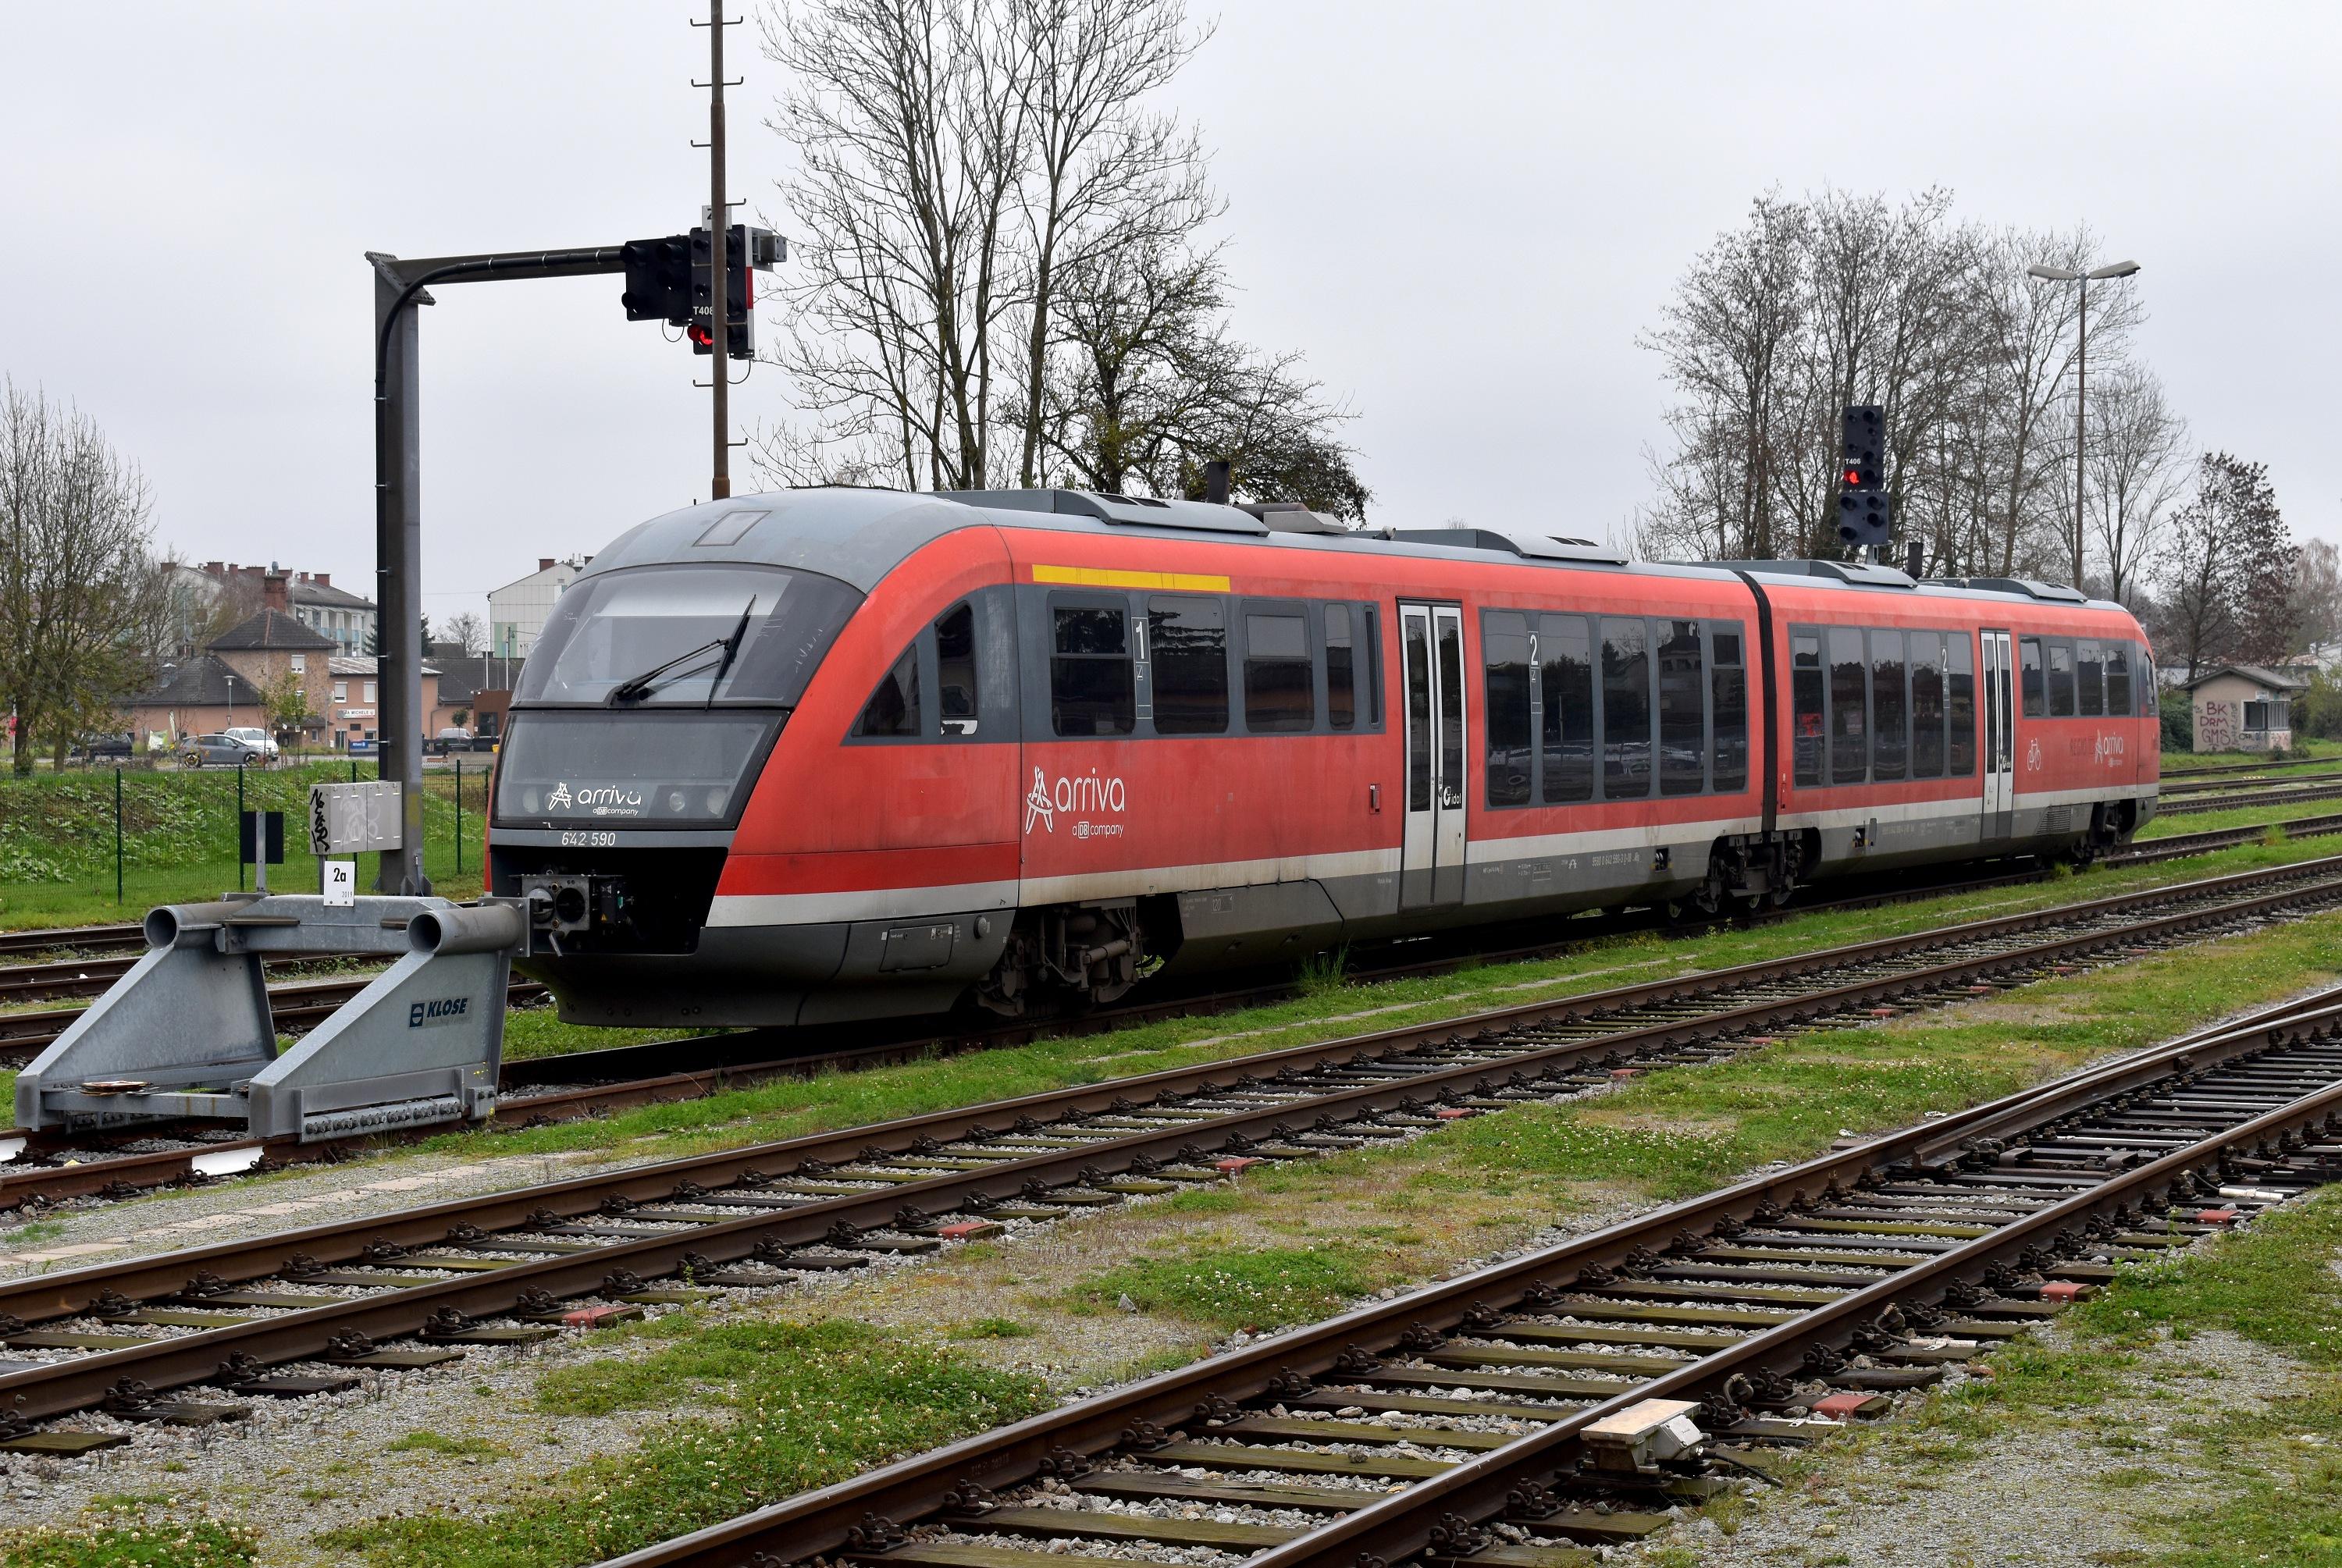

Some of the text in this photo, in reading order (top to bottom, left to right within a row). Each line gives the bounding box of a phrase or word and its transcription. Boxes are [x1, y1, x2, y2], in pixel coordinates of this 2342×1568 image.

[1135, 621, 1144, 659] 1
[1530, 635, 1539, 665] 2
[1942, 649, 1948, 672] 2
[2101, 654, 2106, 676] 2
[2206, 702, 2228, 716] BK
[2200, 716, 2229, 727] DRM
[2201, 729, 2231, 745] GMS
[578, 785, 642, 805] arriva
[1055, 767, 1125, 812] arriva
[561, 832, 616, 846] 642 590
[1090, 824, 1124, 838] company
[333, 867, 347, 882] 2a
[427, 997, 468, 1018] KLOSE
